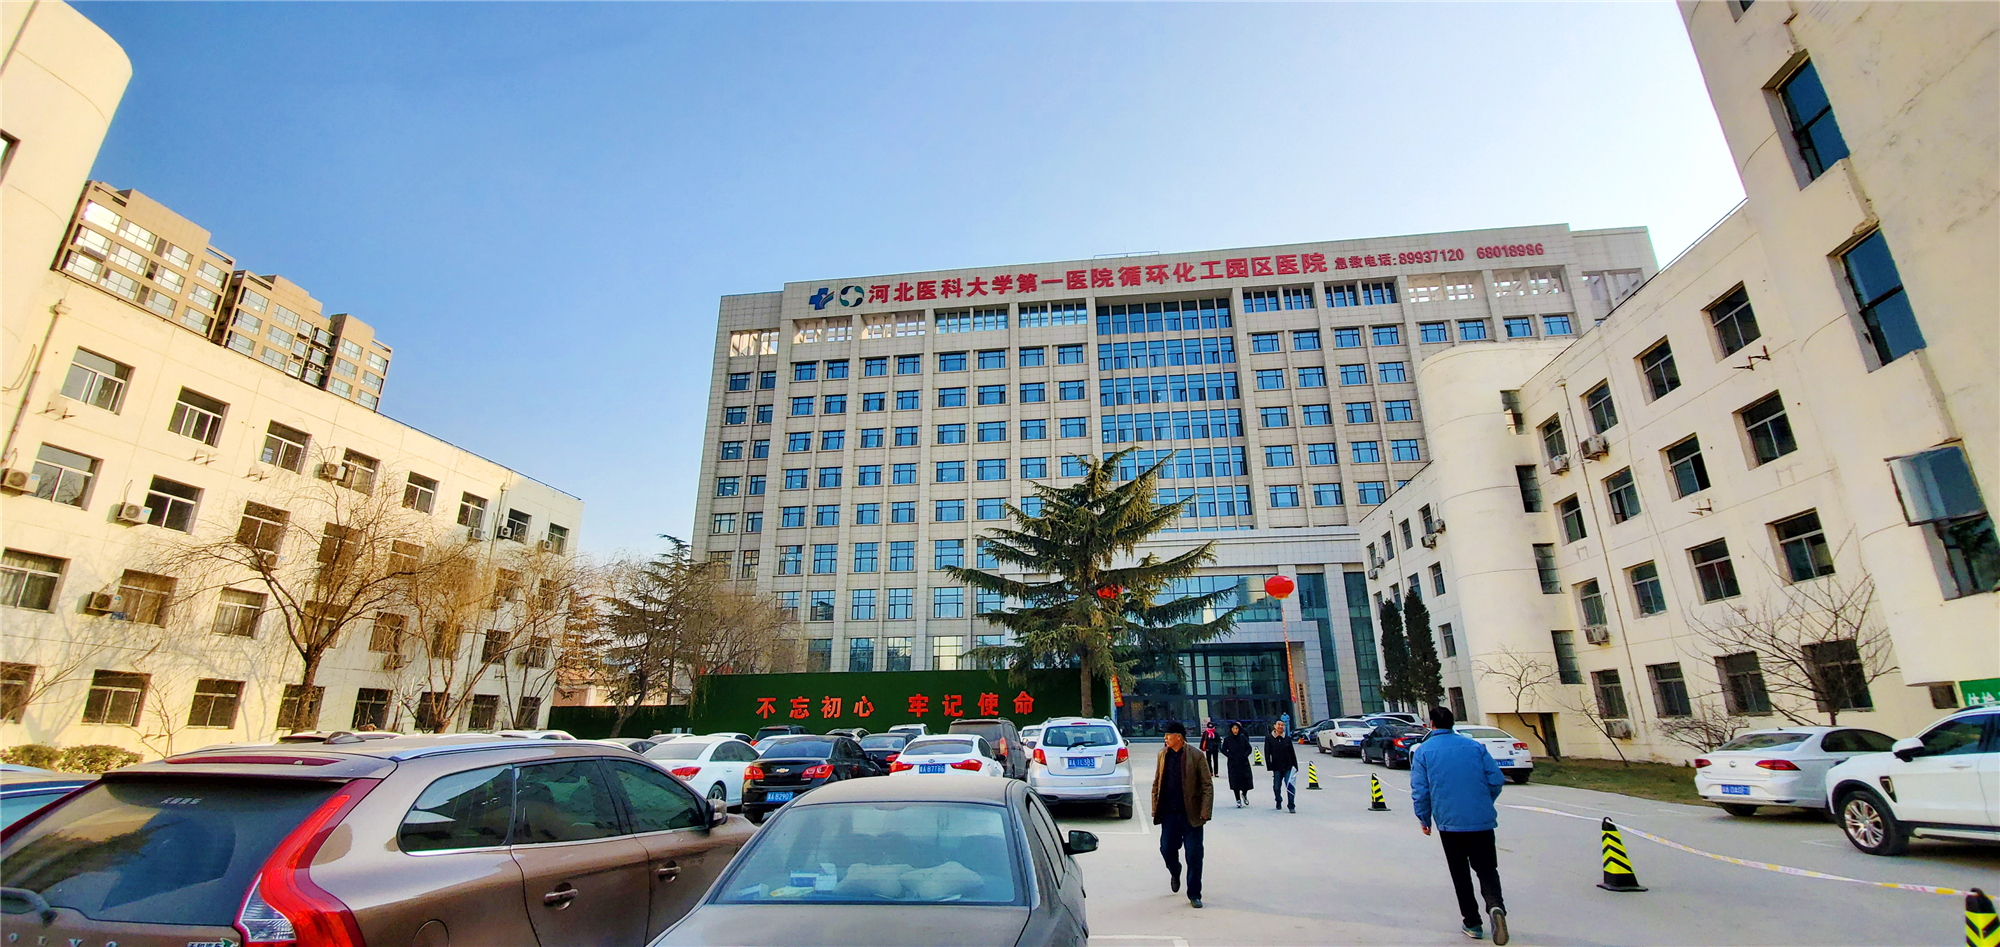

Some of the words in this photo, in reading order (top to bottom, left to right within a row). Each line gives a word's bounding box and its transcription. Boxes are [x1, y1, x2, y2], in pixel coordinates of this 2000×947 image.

[1477, 243, 1544, 260] 68018986
[868, 252, 1328, 304] 河北医科大学第一医院循环化工园区医院
[756, 695, 874, 719] 不忘初心
[908, 691, 1035, 718] 牢记使命
